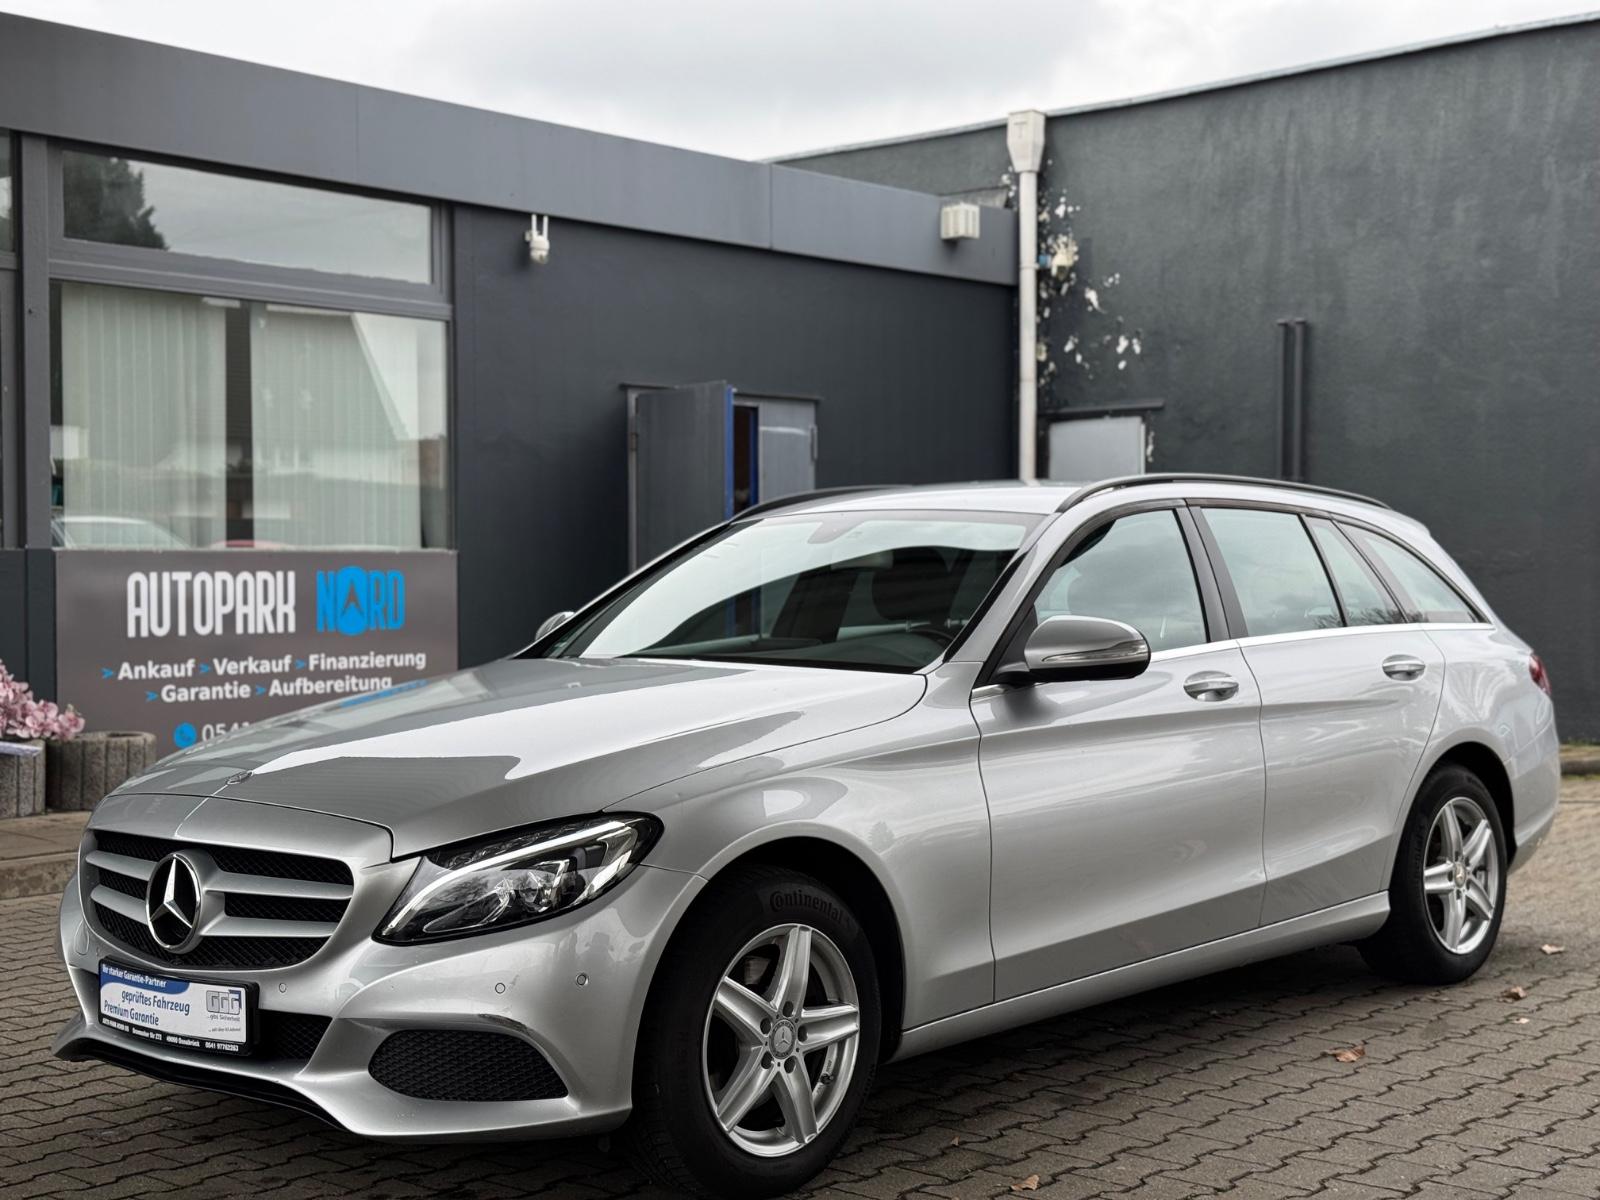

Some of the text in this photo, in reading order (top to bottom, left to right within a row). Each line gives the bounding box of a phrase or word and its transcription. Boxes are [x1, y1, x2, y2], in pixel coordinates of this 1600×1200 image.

[126, 565, 405, 638] AUTOPARK NORD
[118, 650, 427, 680] Ankauf Verkauf Finanzierung
[161, 675, 393, 703] Garantie Aufbereitung
[769, 888, 844, 923] Continental
[104, 1000, 129, 1018] Premium
[129, 1008, 159, 1026] Garantie
[121, 990, 190, 1016] geprüftes Fahrzeug
